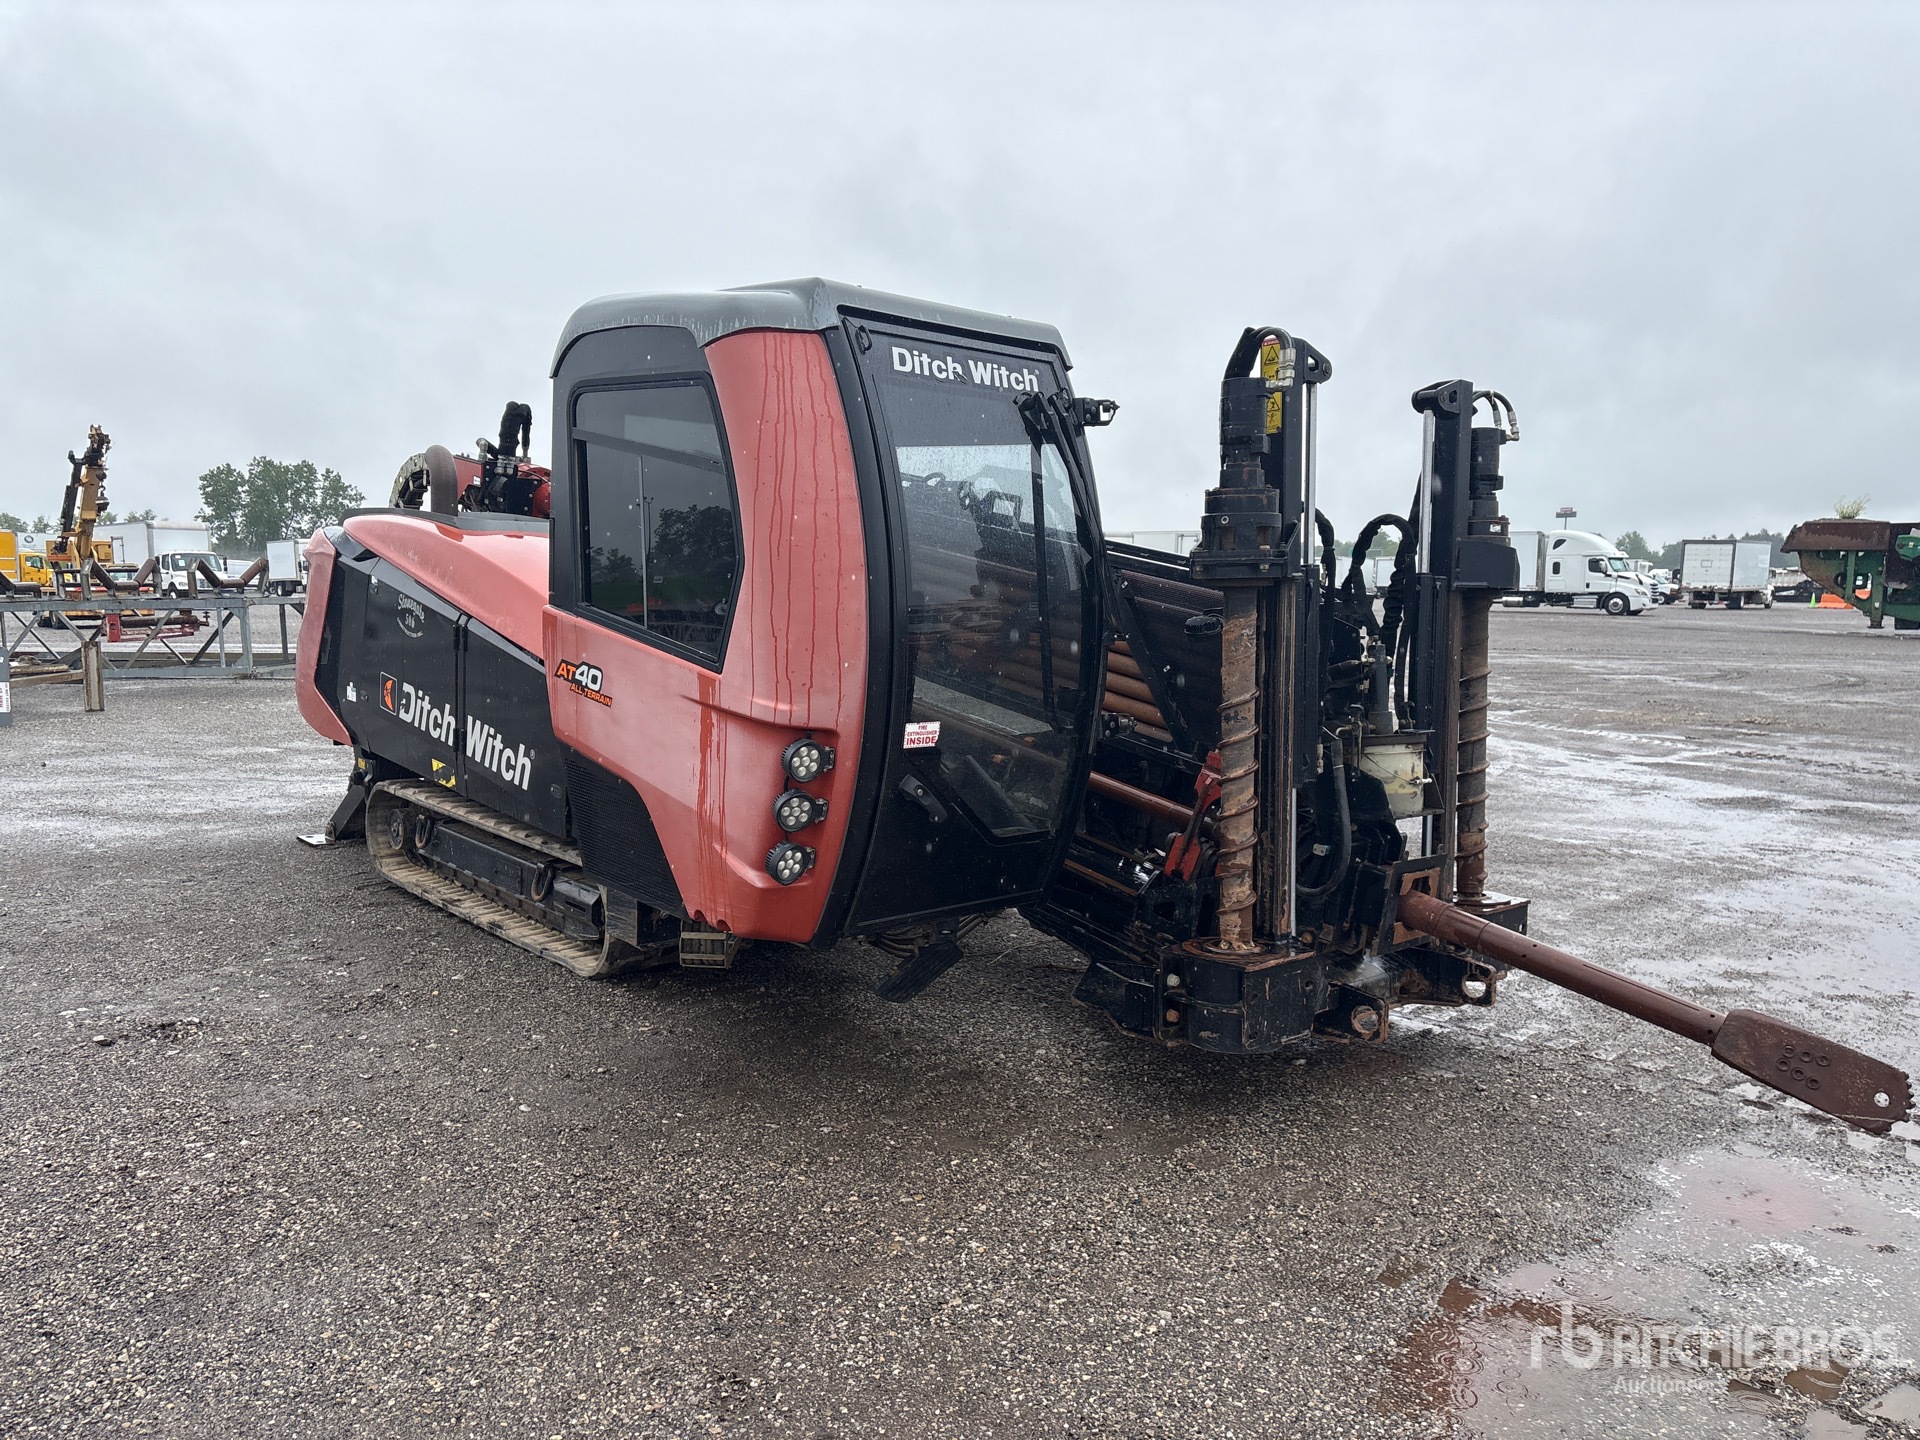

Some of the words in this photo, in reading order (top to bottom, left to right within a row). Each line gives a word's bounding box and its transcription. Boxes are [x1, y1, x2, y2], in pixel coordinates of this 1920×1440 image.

[892, 346, 966, 381] Ditch
[968, 359, 1039, 392] Witch
[570, 683, 583, 695] ALL
[584, 688, 612, 706] TERRAIN
[399, 682, 456, 747] Ditch
[906, 736, 937, 745] INSIDE
